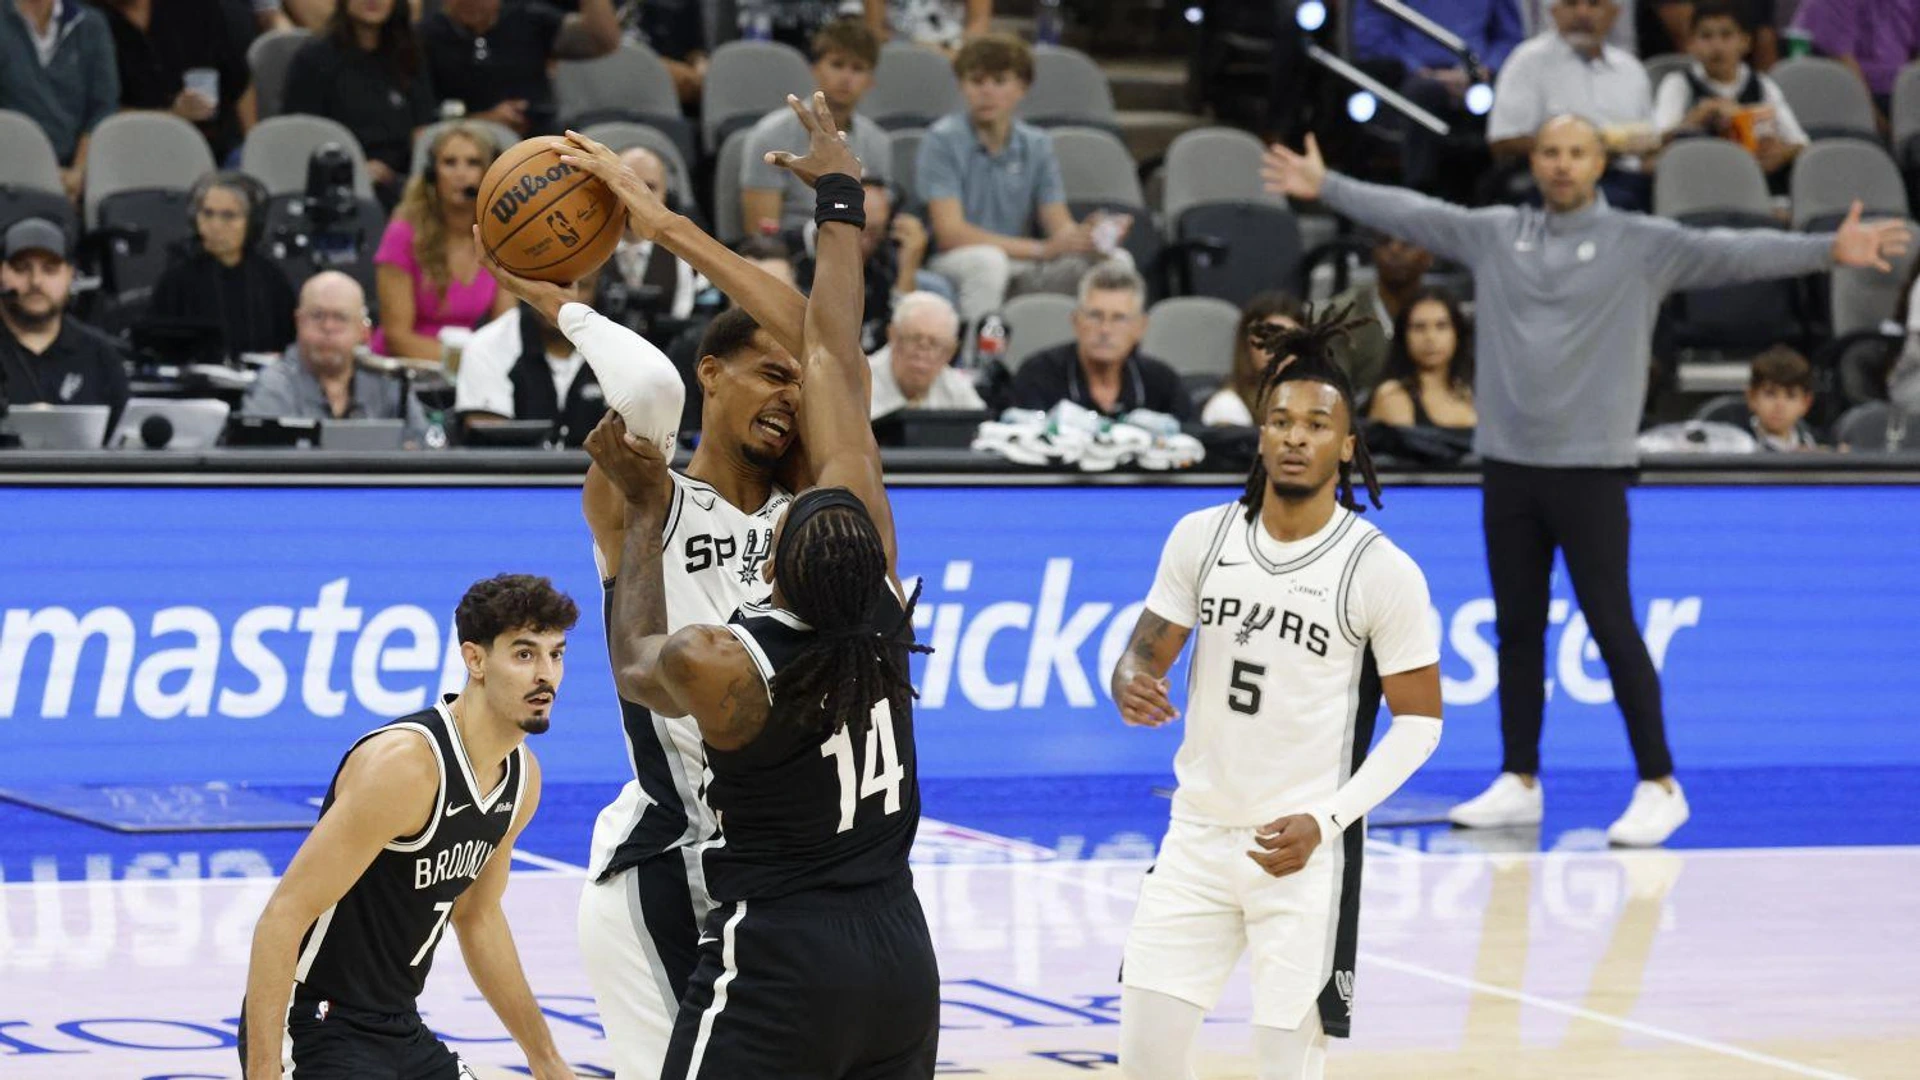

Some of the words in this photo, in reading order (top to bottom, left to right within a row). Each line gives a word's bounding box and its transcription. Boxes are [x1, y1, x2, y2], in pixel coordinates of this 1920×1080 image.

[685, 528, 773, 587] SPU
[1200, 597, 1330, 657] SPURS
[1228, 659, 1266, 716] 5
[820, 697, 904, 834] 14
[415, 840, 495, 890] BROOKLY
